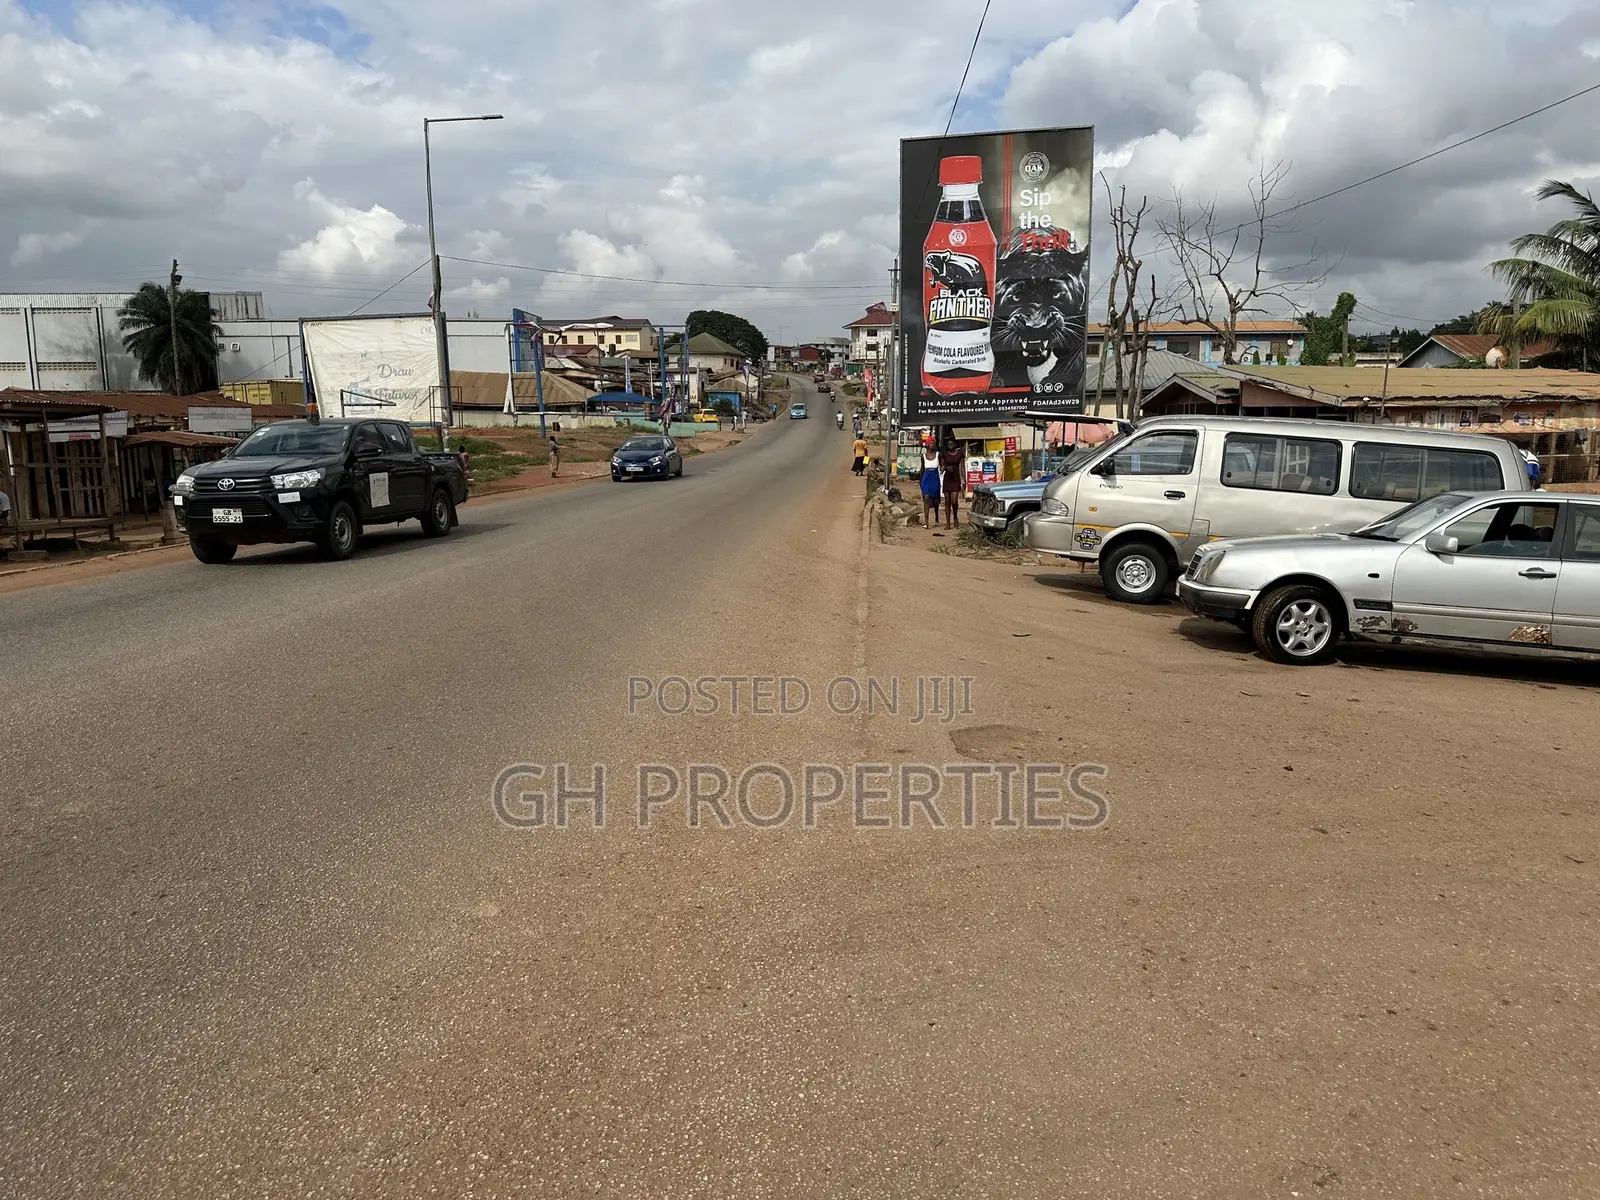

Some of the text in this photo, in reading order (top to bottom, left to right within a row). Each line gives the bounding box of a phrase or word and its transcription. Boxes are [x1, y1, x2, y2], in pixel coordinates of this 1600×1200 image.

[1025, 164, 1043, 173] OAK
[1019, 188, 1052, 210] Sip
[1018, 211, 1052, 229] the
[940, 287, 983, 298] BLACK
[929, 297, 991, 321] PANTHER
[943, 346, 956, 358] COLA
[376, 364, 414, 378] Draw
[991, 397, 1031, 405] Approved.
